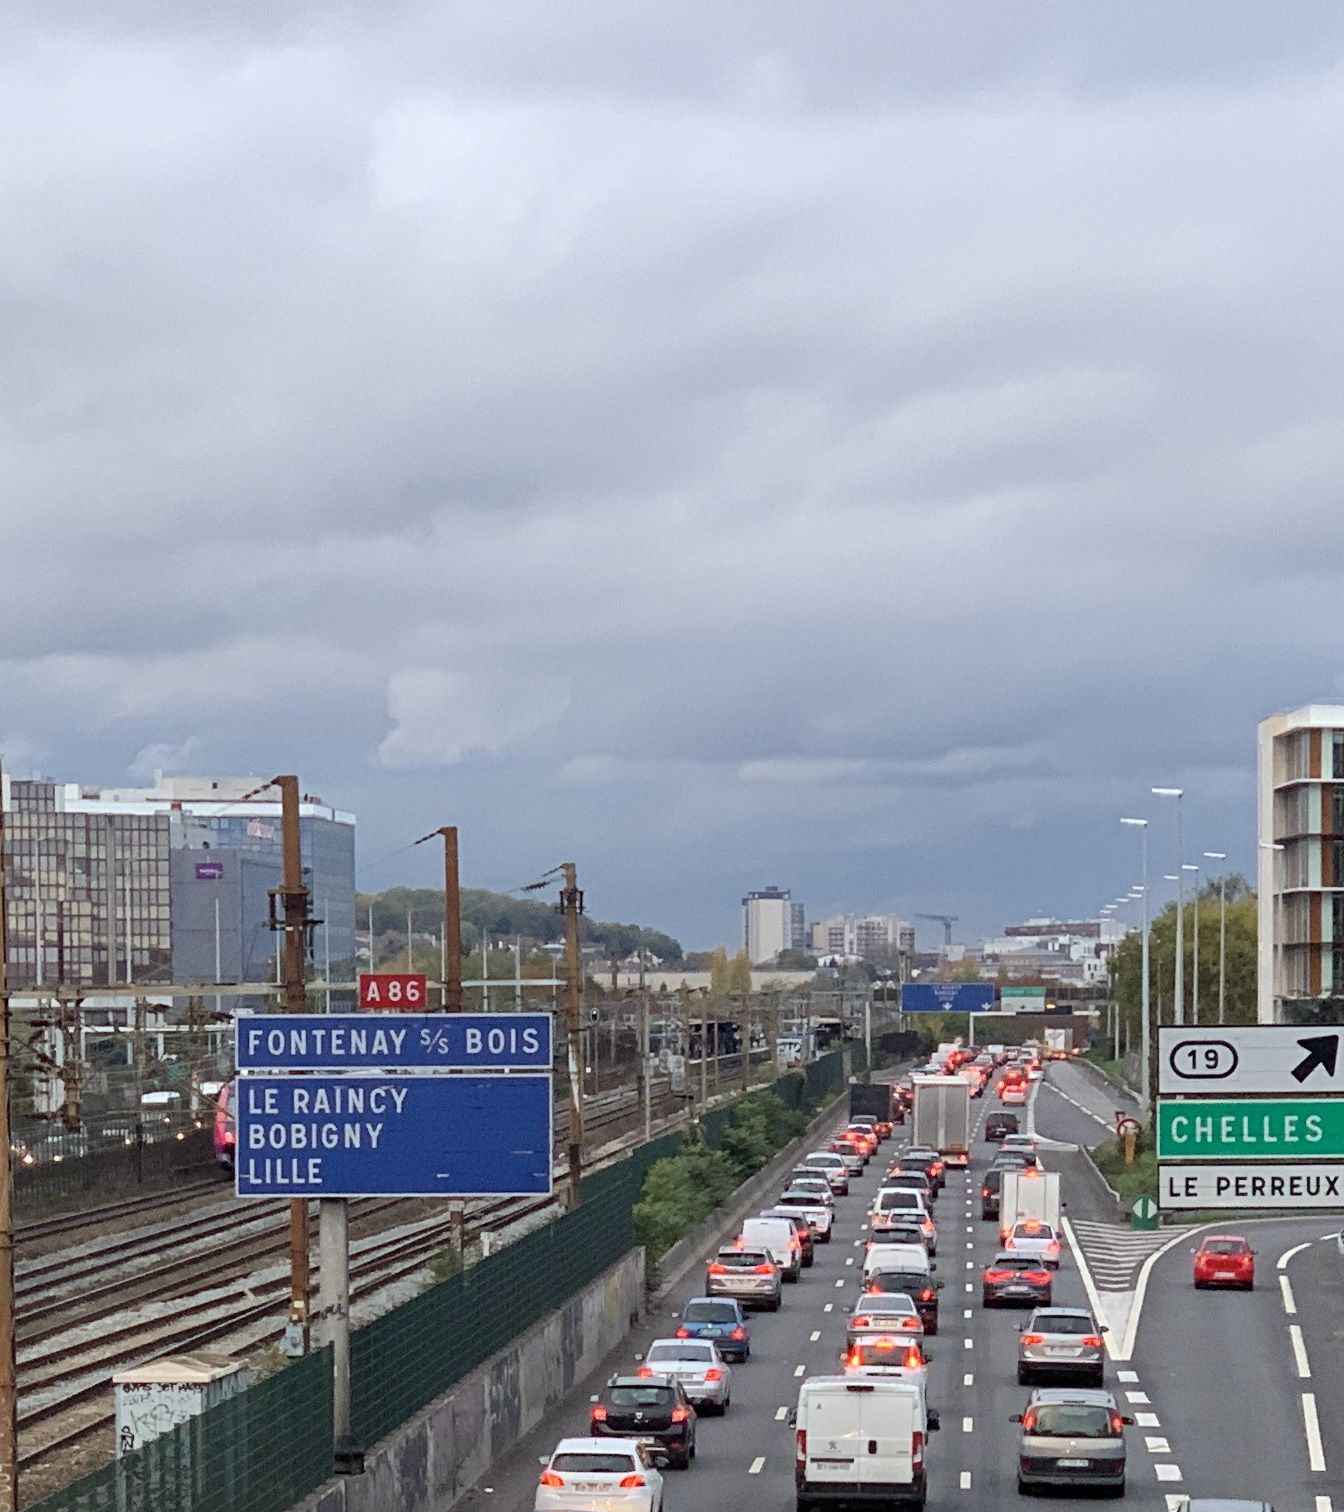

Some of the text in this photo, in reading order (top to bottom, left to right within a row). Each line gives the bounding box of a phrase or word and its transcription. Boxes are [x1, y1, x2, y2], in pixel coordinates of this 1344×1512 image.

[248, 1028, 407, 1056] FONTENAY
[466, 1028, 539, 1054] BOIS
[1187, 1049, 1219, 1070] 19
[248, 1087, 408, 1114] LE RAINCY
[249, 1123, 383, 1150] BOBIGNY
[1171, 1114, 1323, 1144] CHELLES
[249, 1158, 323, 1184] LILLE
[1169, 1176, 1340, 1198] LE PERREUX
